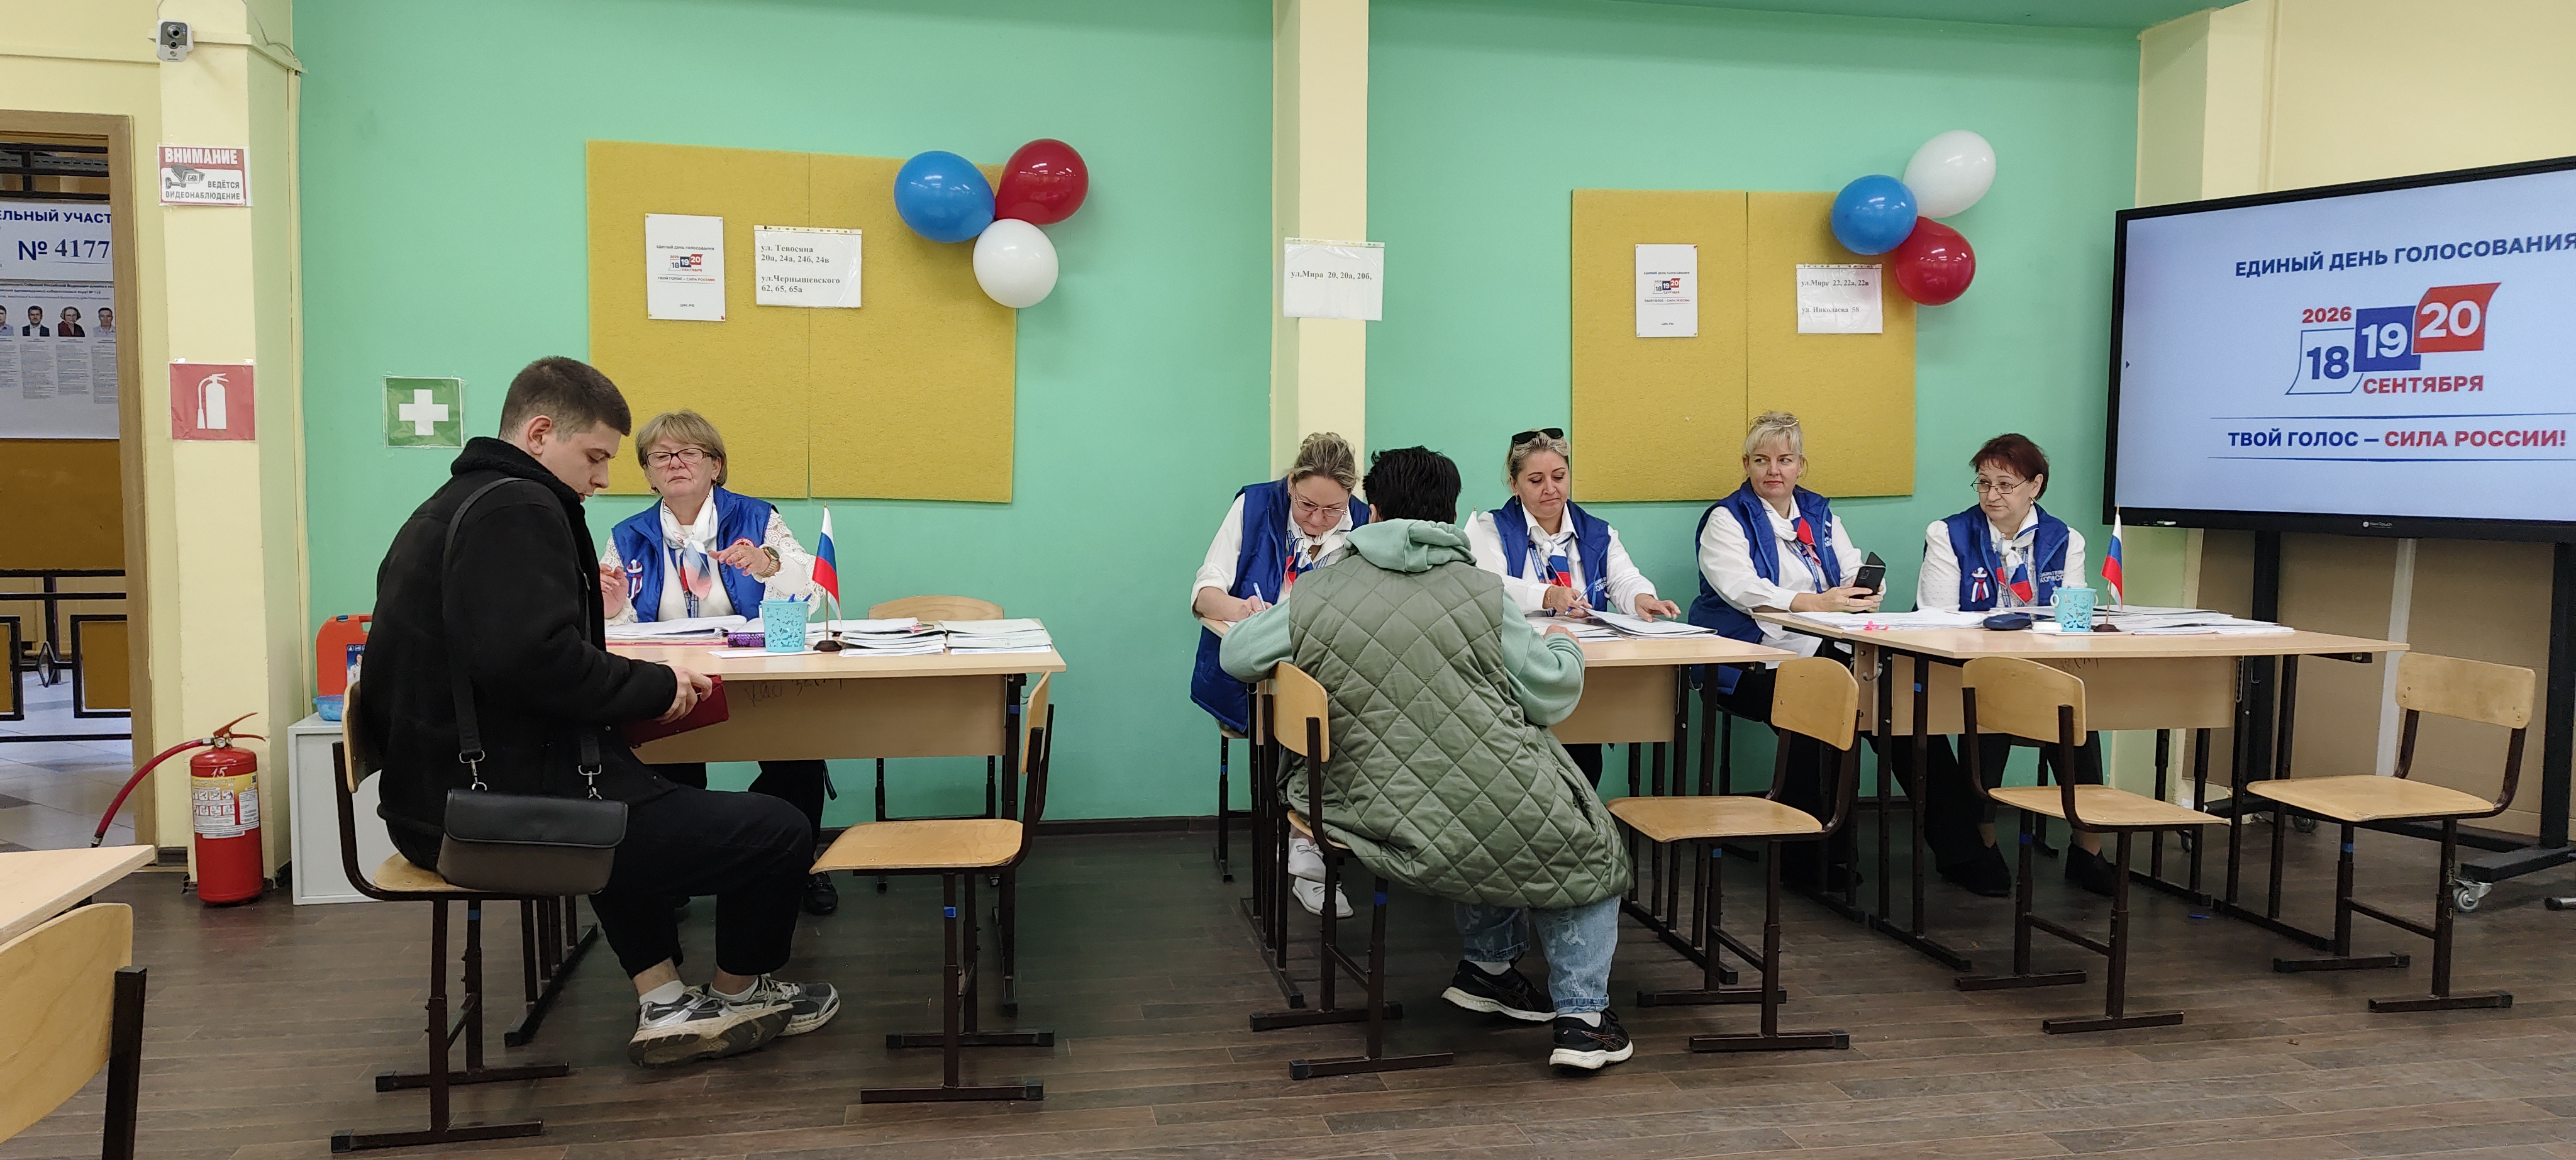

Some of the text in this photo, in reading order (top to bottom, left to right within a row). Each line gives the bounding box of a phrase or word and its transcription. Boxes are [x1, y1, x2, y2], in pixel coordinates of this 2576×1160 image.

[165, 148, 238, 164] ВНИМАНИЕ
[208, 180, 240, 189] ВЕДЁТСЯ
[165, 191, 240, 200] ВИДЕОНАБЛЮДЕНИЕ
[0, 209, 59, 221] ЛЬНЫЙ
[18, 238, 109, 260] № 4177
[775, 244, 813, 253] Тевосяна
[2235, 232, 2576, 277] ЕДИНЫЙ ДЕНЬ ГОЛОСОВАНИЯ
[761, 254, 777, 262] 20а,
[779, 255, 796, 263] 24а,
[797, 255, 814, 264] 24б,
[761, 275, 840, 284] ул.Чернышевского
[1291, 270, 1324, 279] ул.Мира
[1328, 271, 1338, 279] 20,
[762, 284, 773, 293] 62,
[775, 285, 787, 293] 65,
[2302, 306, 2352, 324] 2026
[2306, 300, 2480, 381] 18 19 20
[2363, 375, 2484, 394] СЕНТЯБРЯ
[2228, 428, 2282, 447] ТВОЙ
[2287, 431, 2358, 447] ГОЛОС
[2385, 431, 2448, 447] СИЛА
[2455, 430, 2567, 447] РОССИИ!
